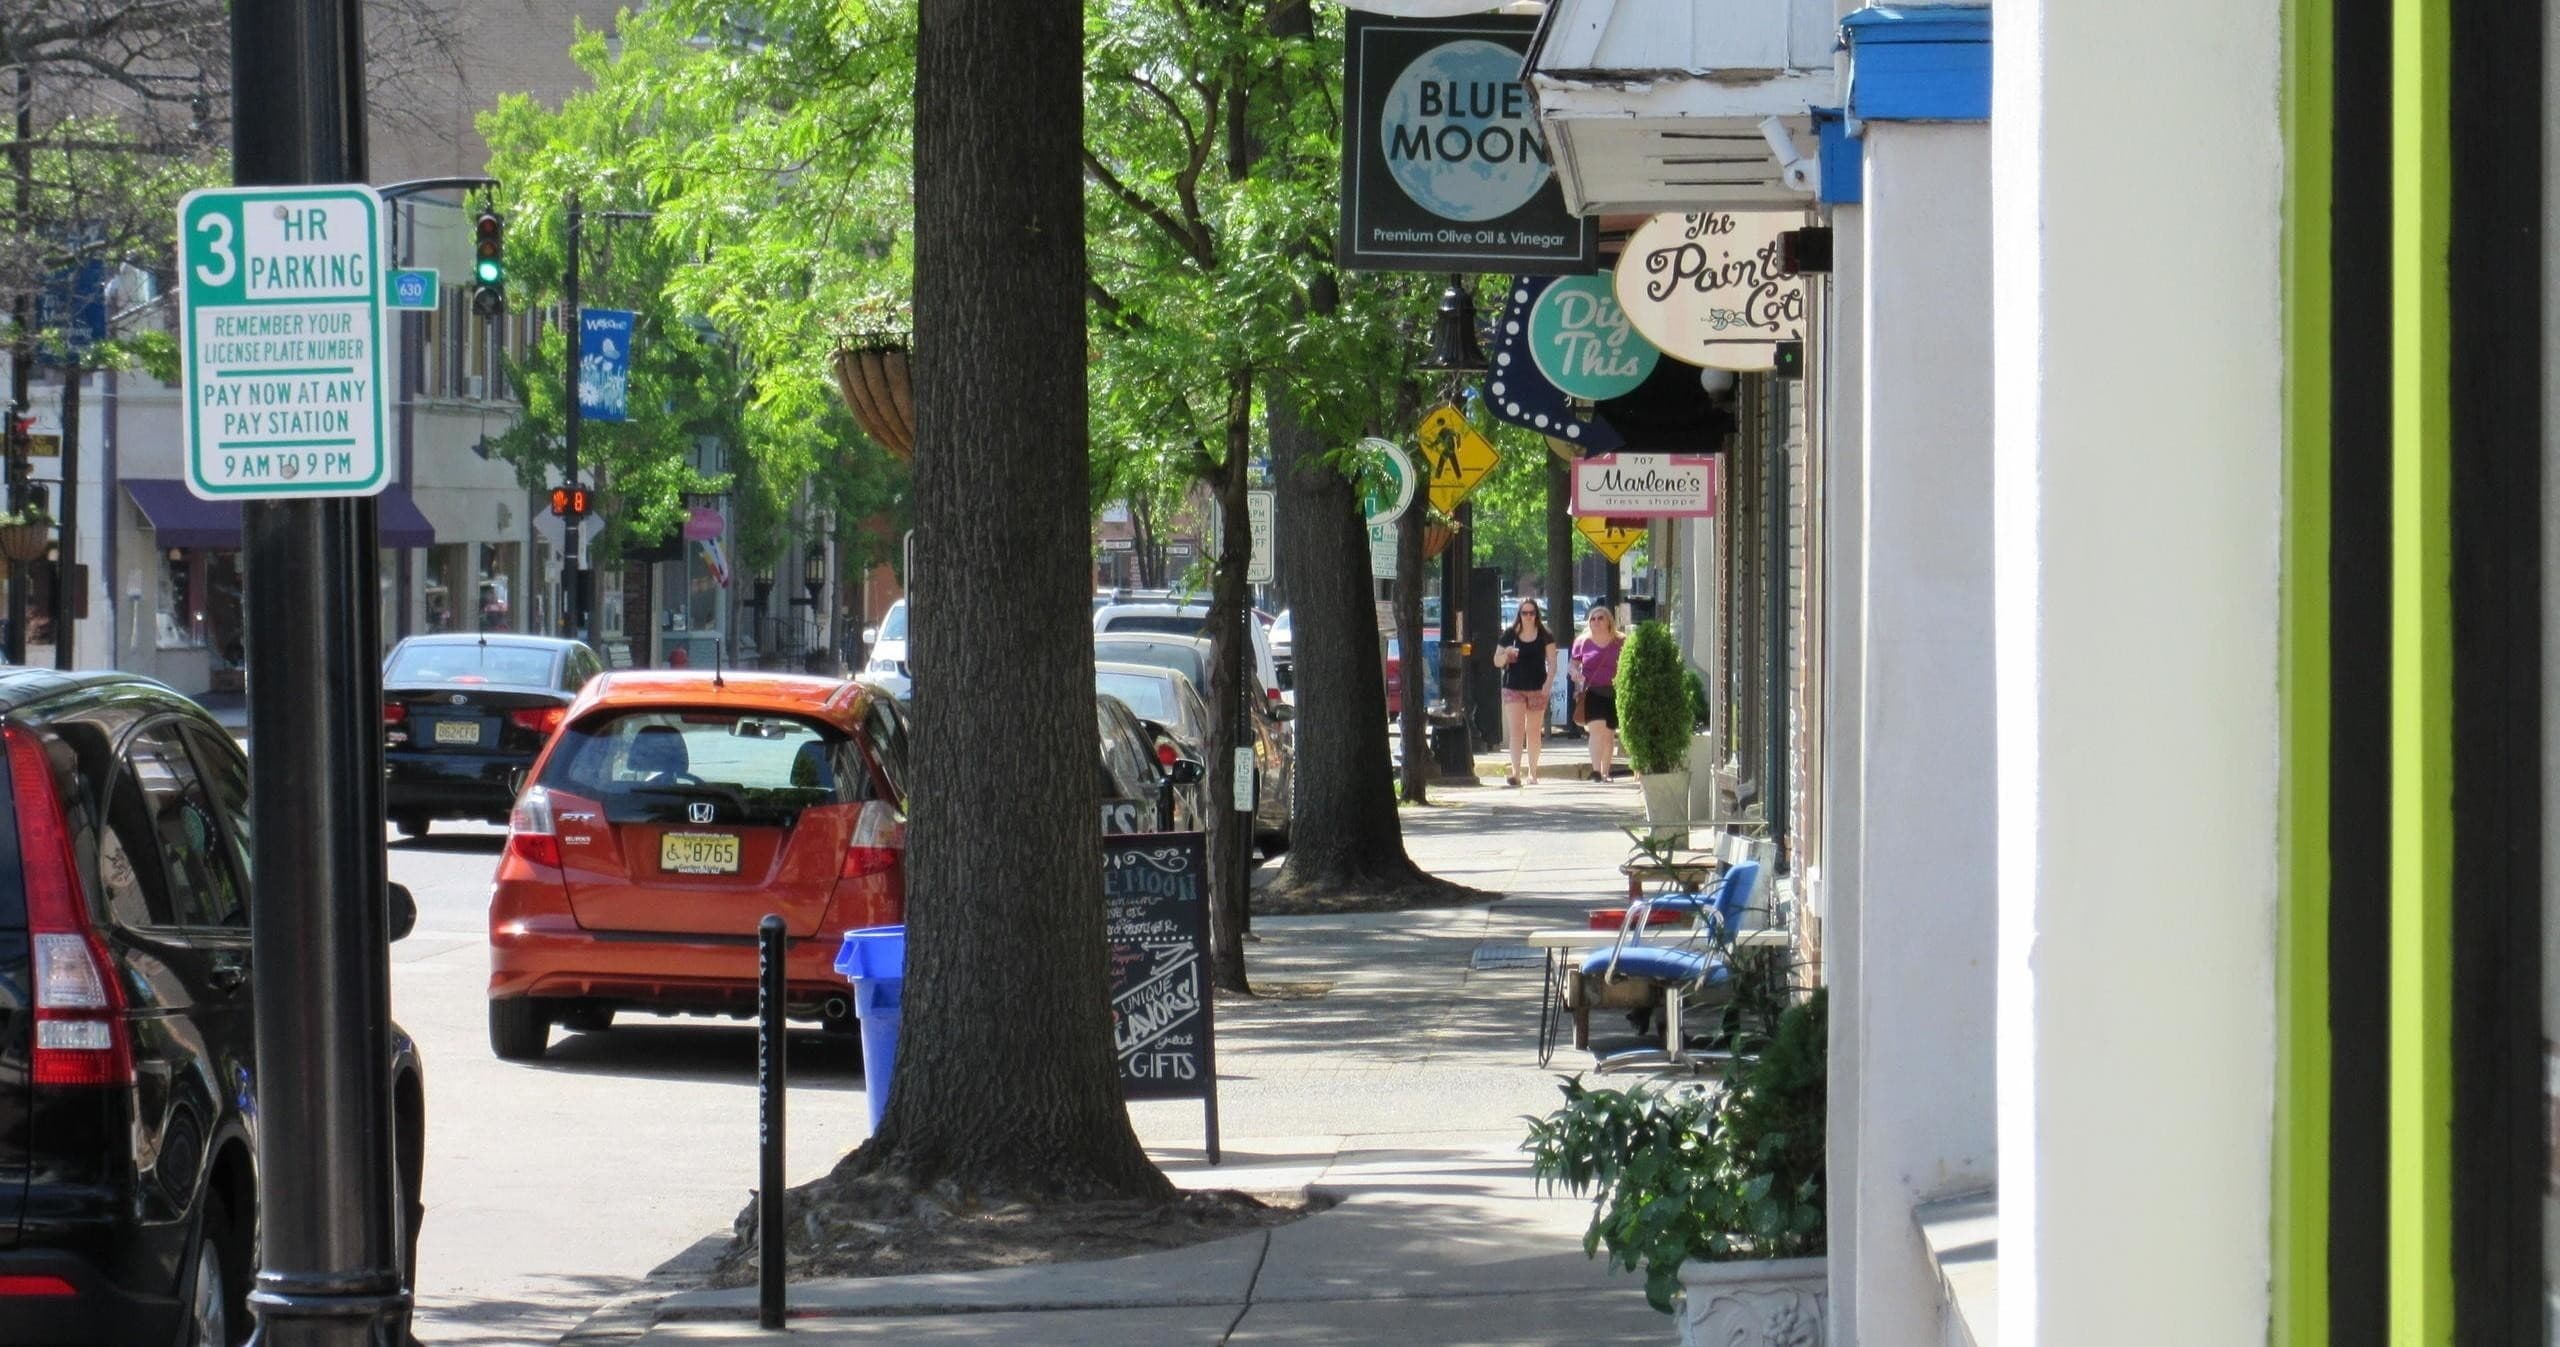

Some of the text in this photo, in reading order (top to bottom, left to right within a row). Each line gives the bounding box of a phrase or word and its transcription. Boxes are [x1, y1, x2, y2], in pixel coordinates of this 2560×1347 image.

[1420, 81, 1522, 119] BLUE
[1390, 125, 1552, 164] MOON
[284, 208, 328, 241] HR
[1373, 228, 1565, 249] Premium Olive Oil & Vinegar
[1685, 211, 1735, 240] The
[196, 212, 236, 287] 3
[251, 253, 364, 289] PARKING
[1646, 240, 1798, 302] Paint
[400, 283, 421, 297] 630
[215, 313, 352, 336] REMEMBER YOUR
[1554, 290, 1629, 347] Dig
[205, 339, 364, 364] LICENSE PLATE NUMBER
[1554, 331, 1639, 376] This
[204, 380, 366, 407] PAY NOW AT ANY
[225, 410, 349, 435] PAY STATION
[225, 452, 351, 477] 9 AM TO 9 PM
[1633, 456, 1654, 465] 707
[1586, 469, 1700, 492] Marlene's
[1649, 497, 1696, 507] shoppe
[1114, 960, 1201, 1050] LAVORS!
[1121, 973, 1175, 1014] UNIQUE
[1129, 1051, 1197, 1080] GIFTS
